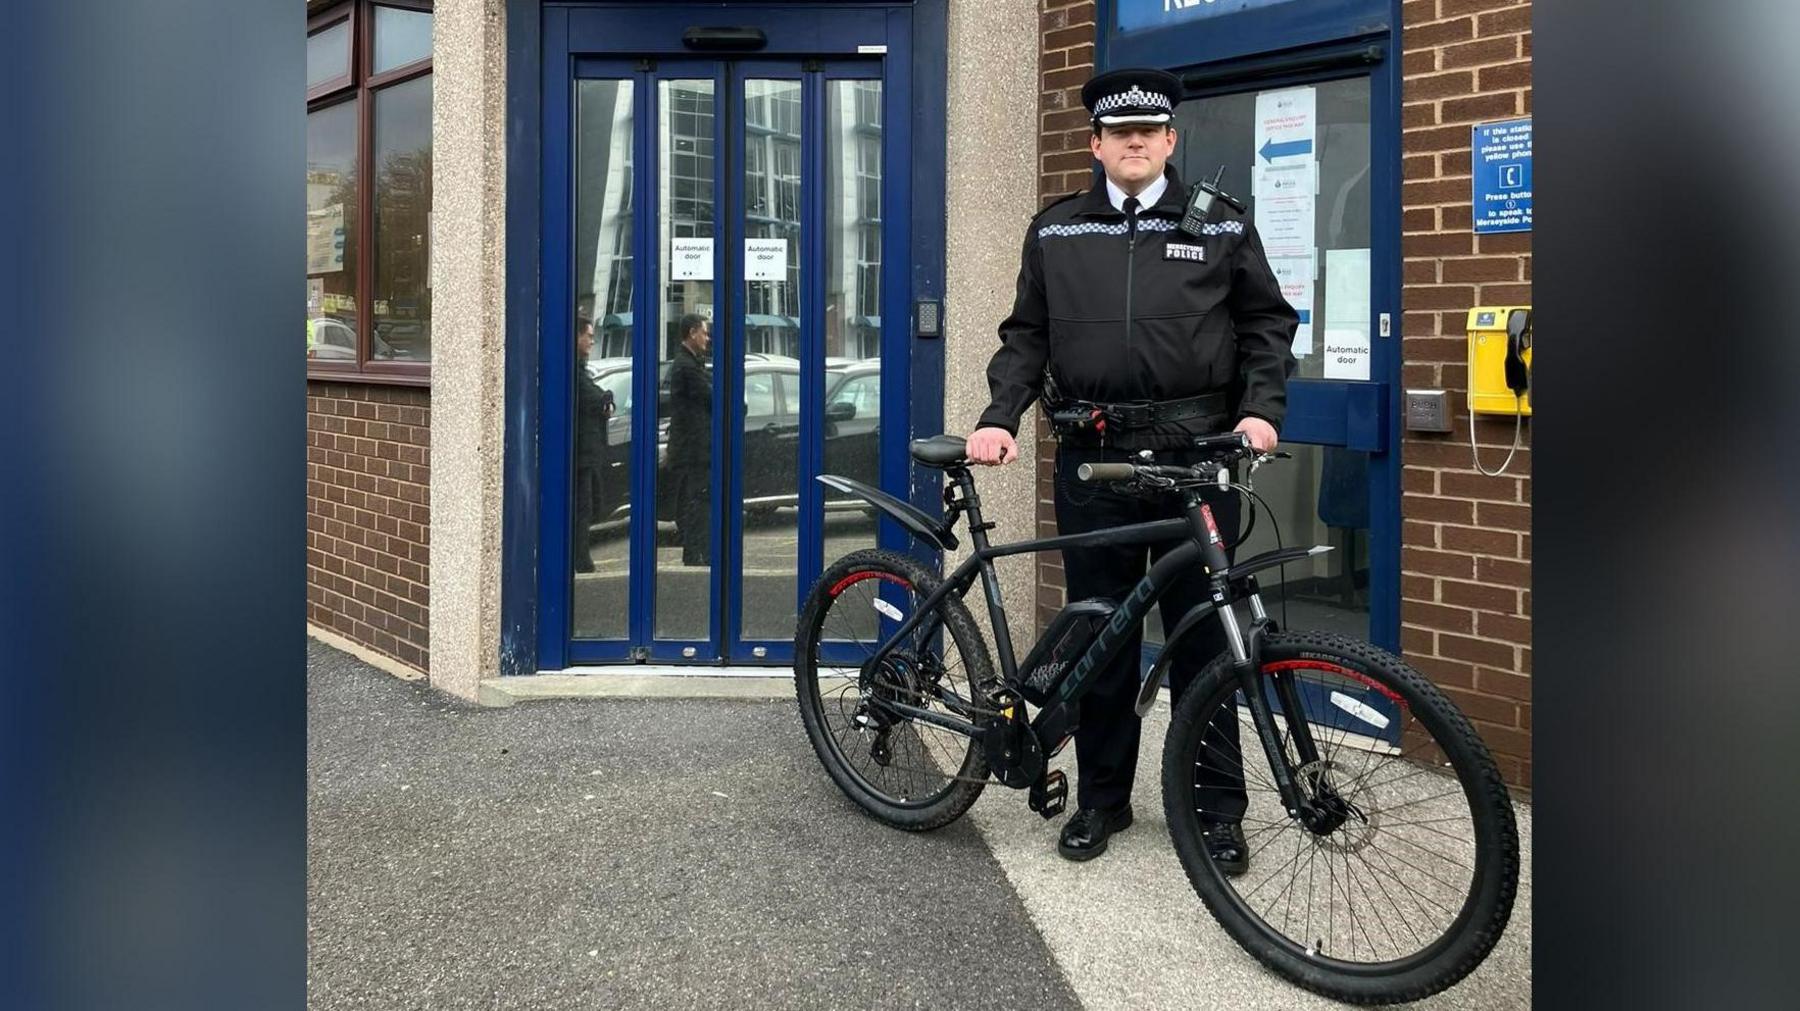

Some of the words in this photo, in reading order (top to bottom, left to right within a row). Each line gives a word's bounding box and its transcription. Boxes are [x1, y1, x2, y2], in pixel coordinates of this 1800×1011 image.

[1483, 129, 1490, 137] If
[1492, 127, 1507, 136] this
[1492, 136, 1499, 144] is
[1502, 133, 1529, 143] closed
[1481, 145, 1507, 154] please
[1485, 153, 1509, 163] yellow
[1485, 193, 1508, 201] Press
[1499, 208, 1522, 218] speak
[1476, 217, 1520, 227] Merseyside
[1166, 249, 1204, 261] POLICE
[1326, 345, 1369, 354] Automatic
[1060, 576, 1155, 700] carrera
